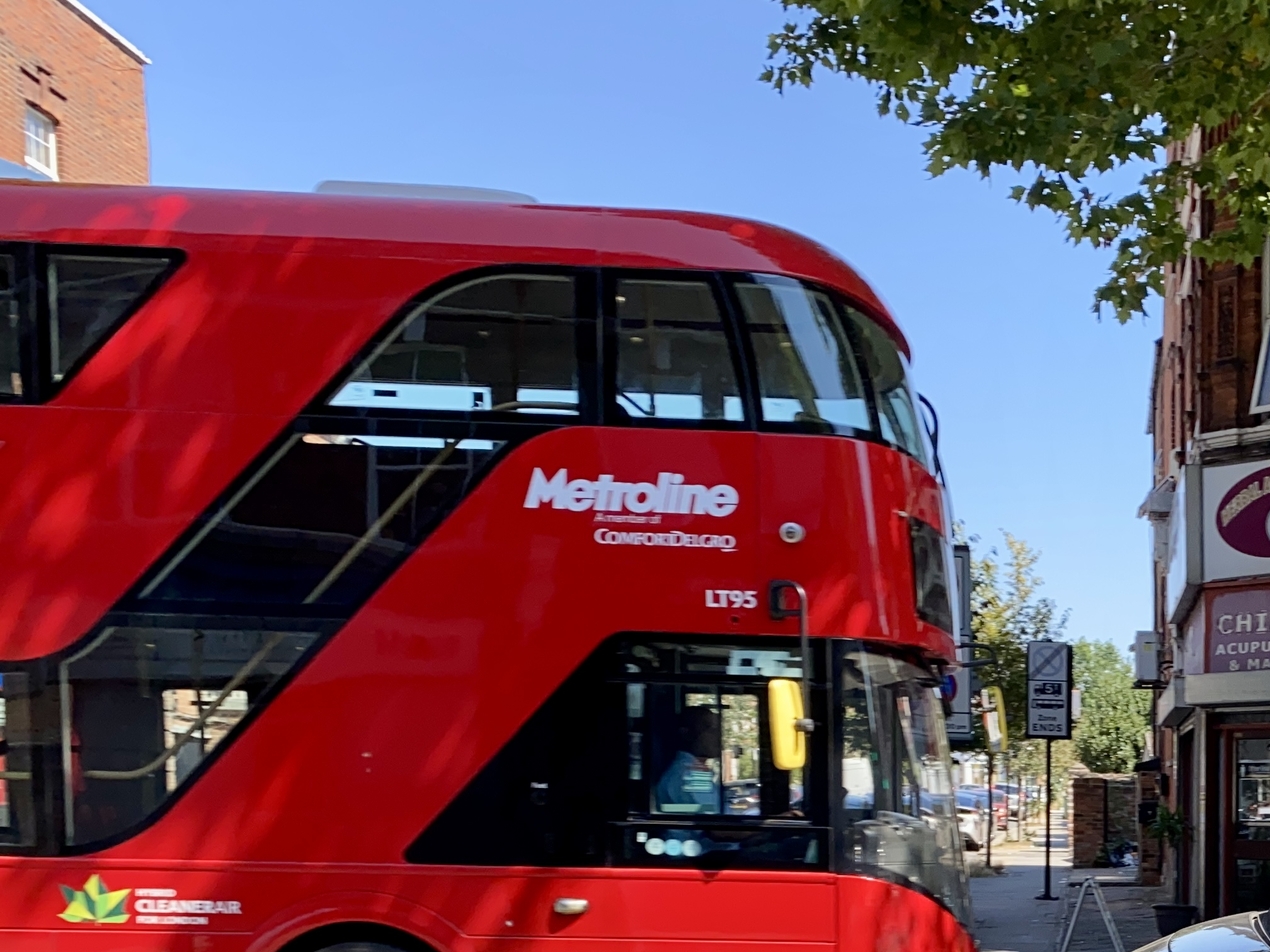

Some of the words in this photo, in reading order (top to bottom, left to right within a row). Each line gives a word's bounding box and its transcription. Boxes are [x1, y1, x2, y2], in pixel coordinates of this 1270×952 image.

[523, 467, 739, 517] Metroline
[705, 589, 758, 608] LT95
[1229, 659, 1240, 671] &
[1033, 723, 1063, 732] ENDS
